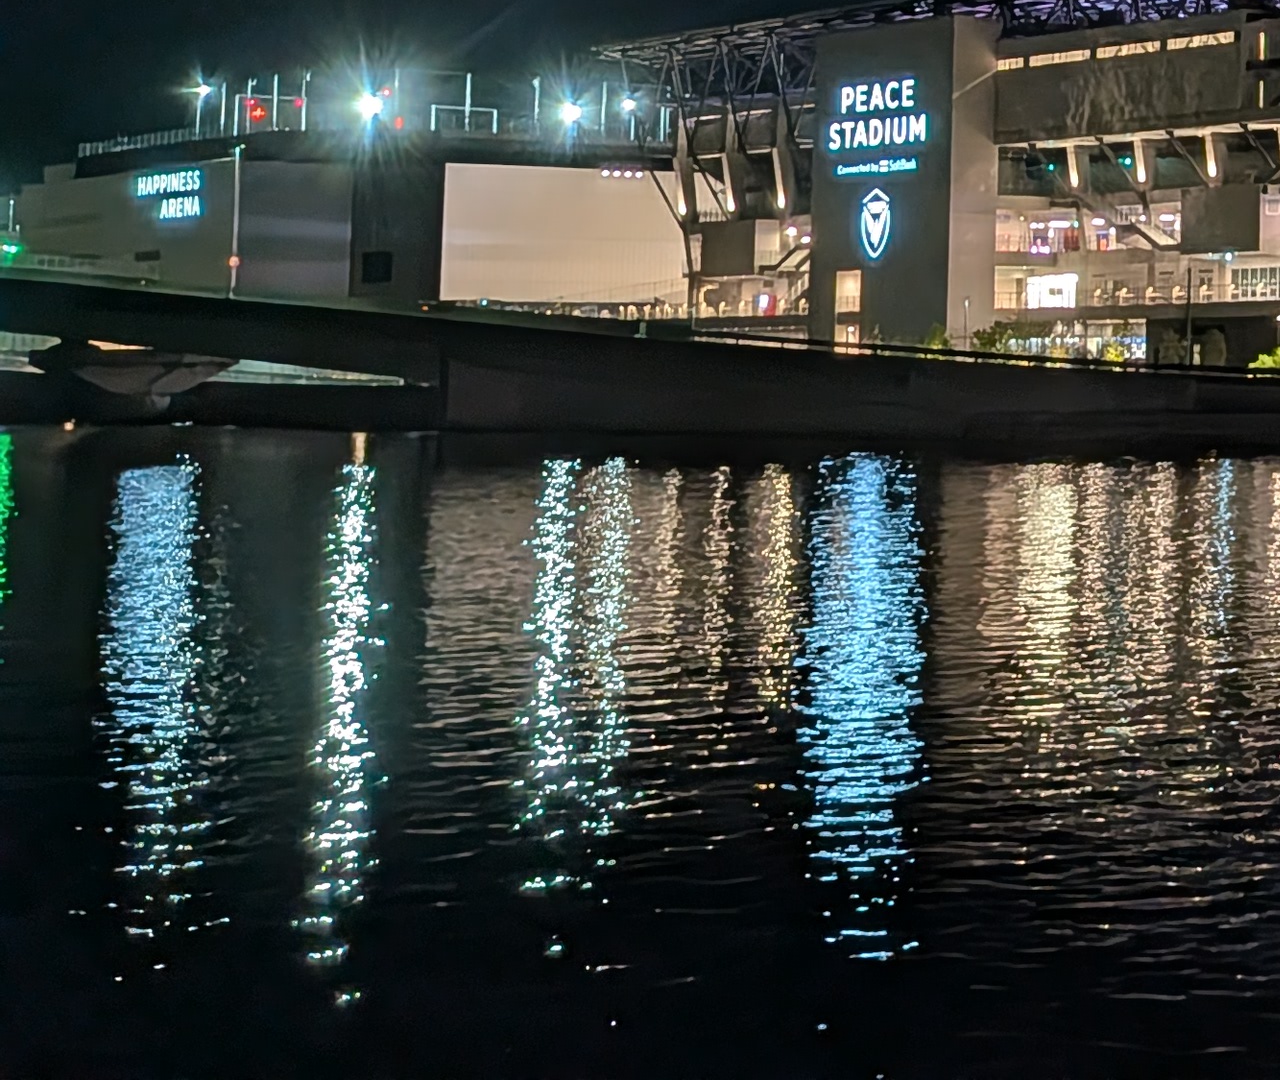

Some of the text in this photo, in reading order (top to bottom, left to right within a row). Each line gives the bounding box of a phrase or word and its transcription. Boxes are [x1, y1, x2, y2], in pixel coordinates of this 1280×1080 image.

[841, 79, 915, 114] PEACE
[828, 113, 926, 151] STADIUM
[137, 169, 200, 196] HAPPINESS
[159, 195, 200, 219] ARENA
